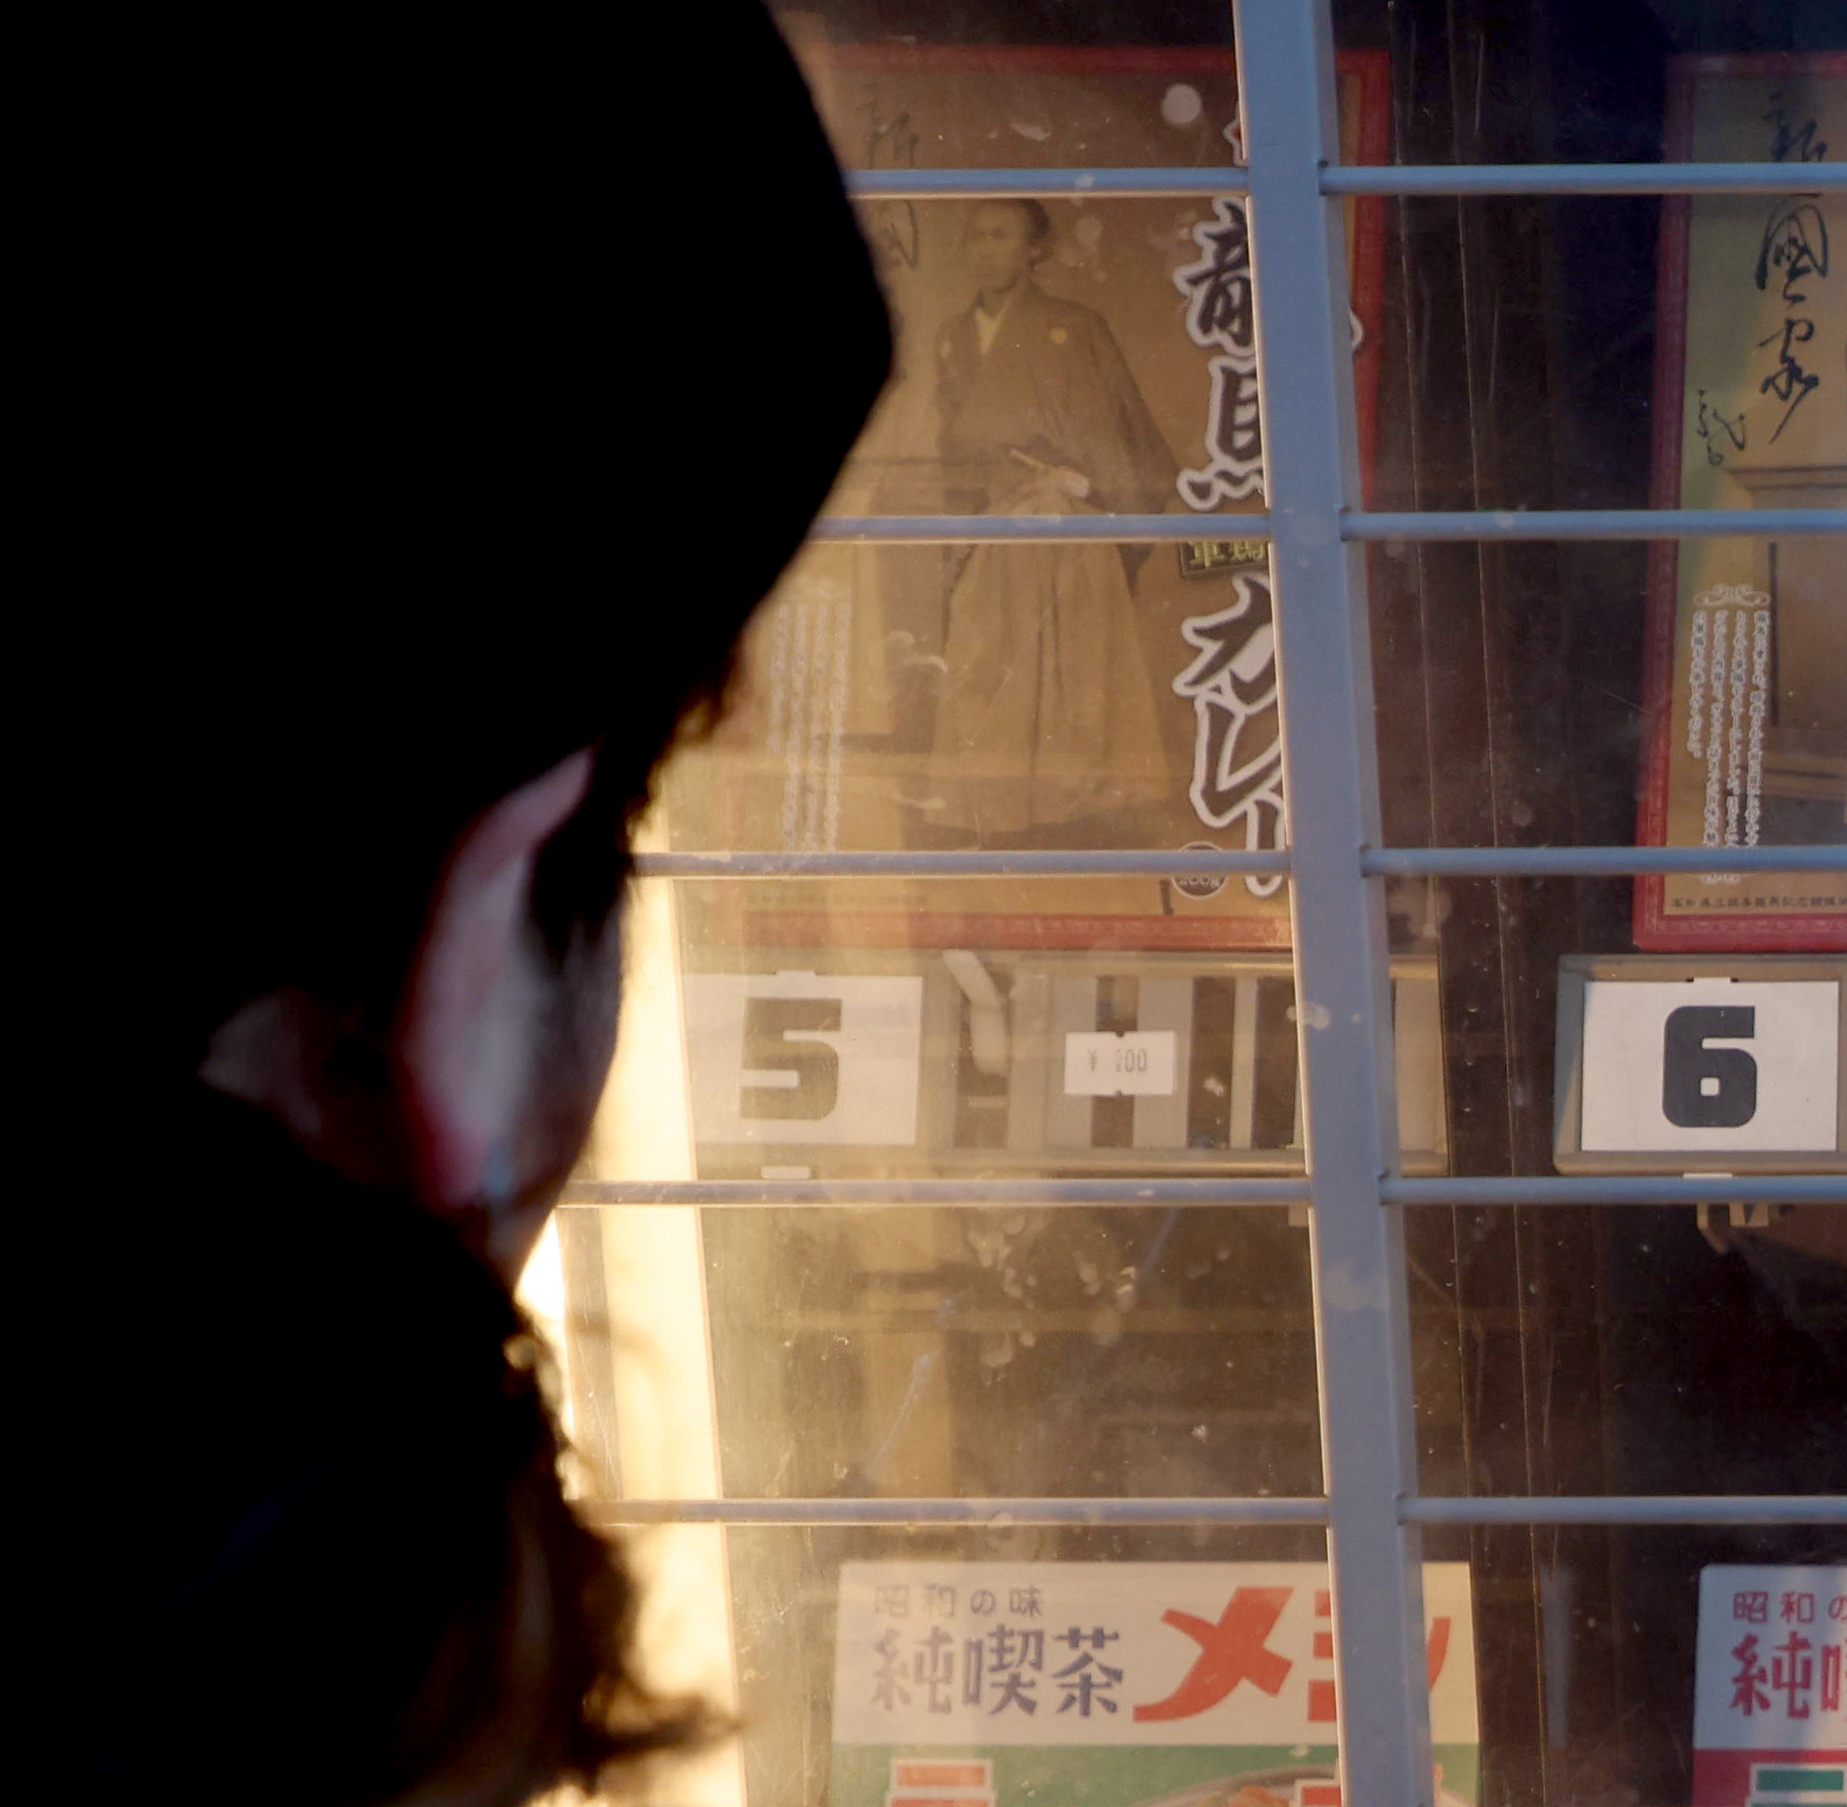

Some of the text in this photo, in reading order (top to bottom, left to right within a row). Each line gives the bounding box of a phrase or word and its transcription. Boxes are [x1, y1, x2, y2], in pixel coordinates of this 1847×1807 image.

[739, 997, 842, 1121] 5
[1662, 1005, 1757, 1128] 6
[874, 1584, 1042, 1618] 昭和の味
[870, 1624, 1124, 1719] 純喫茶
